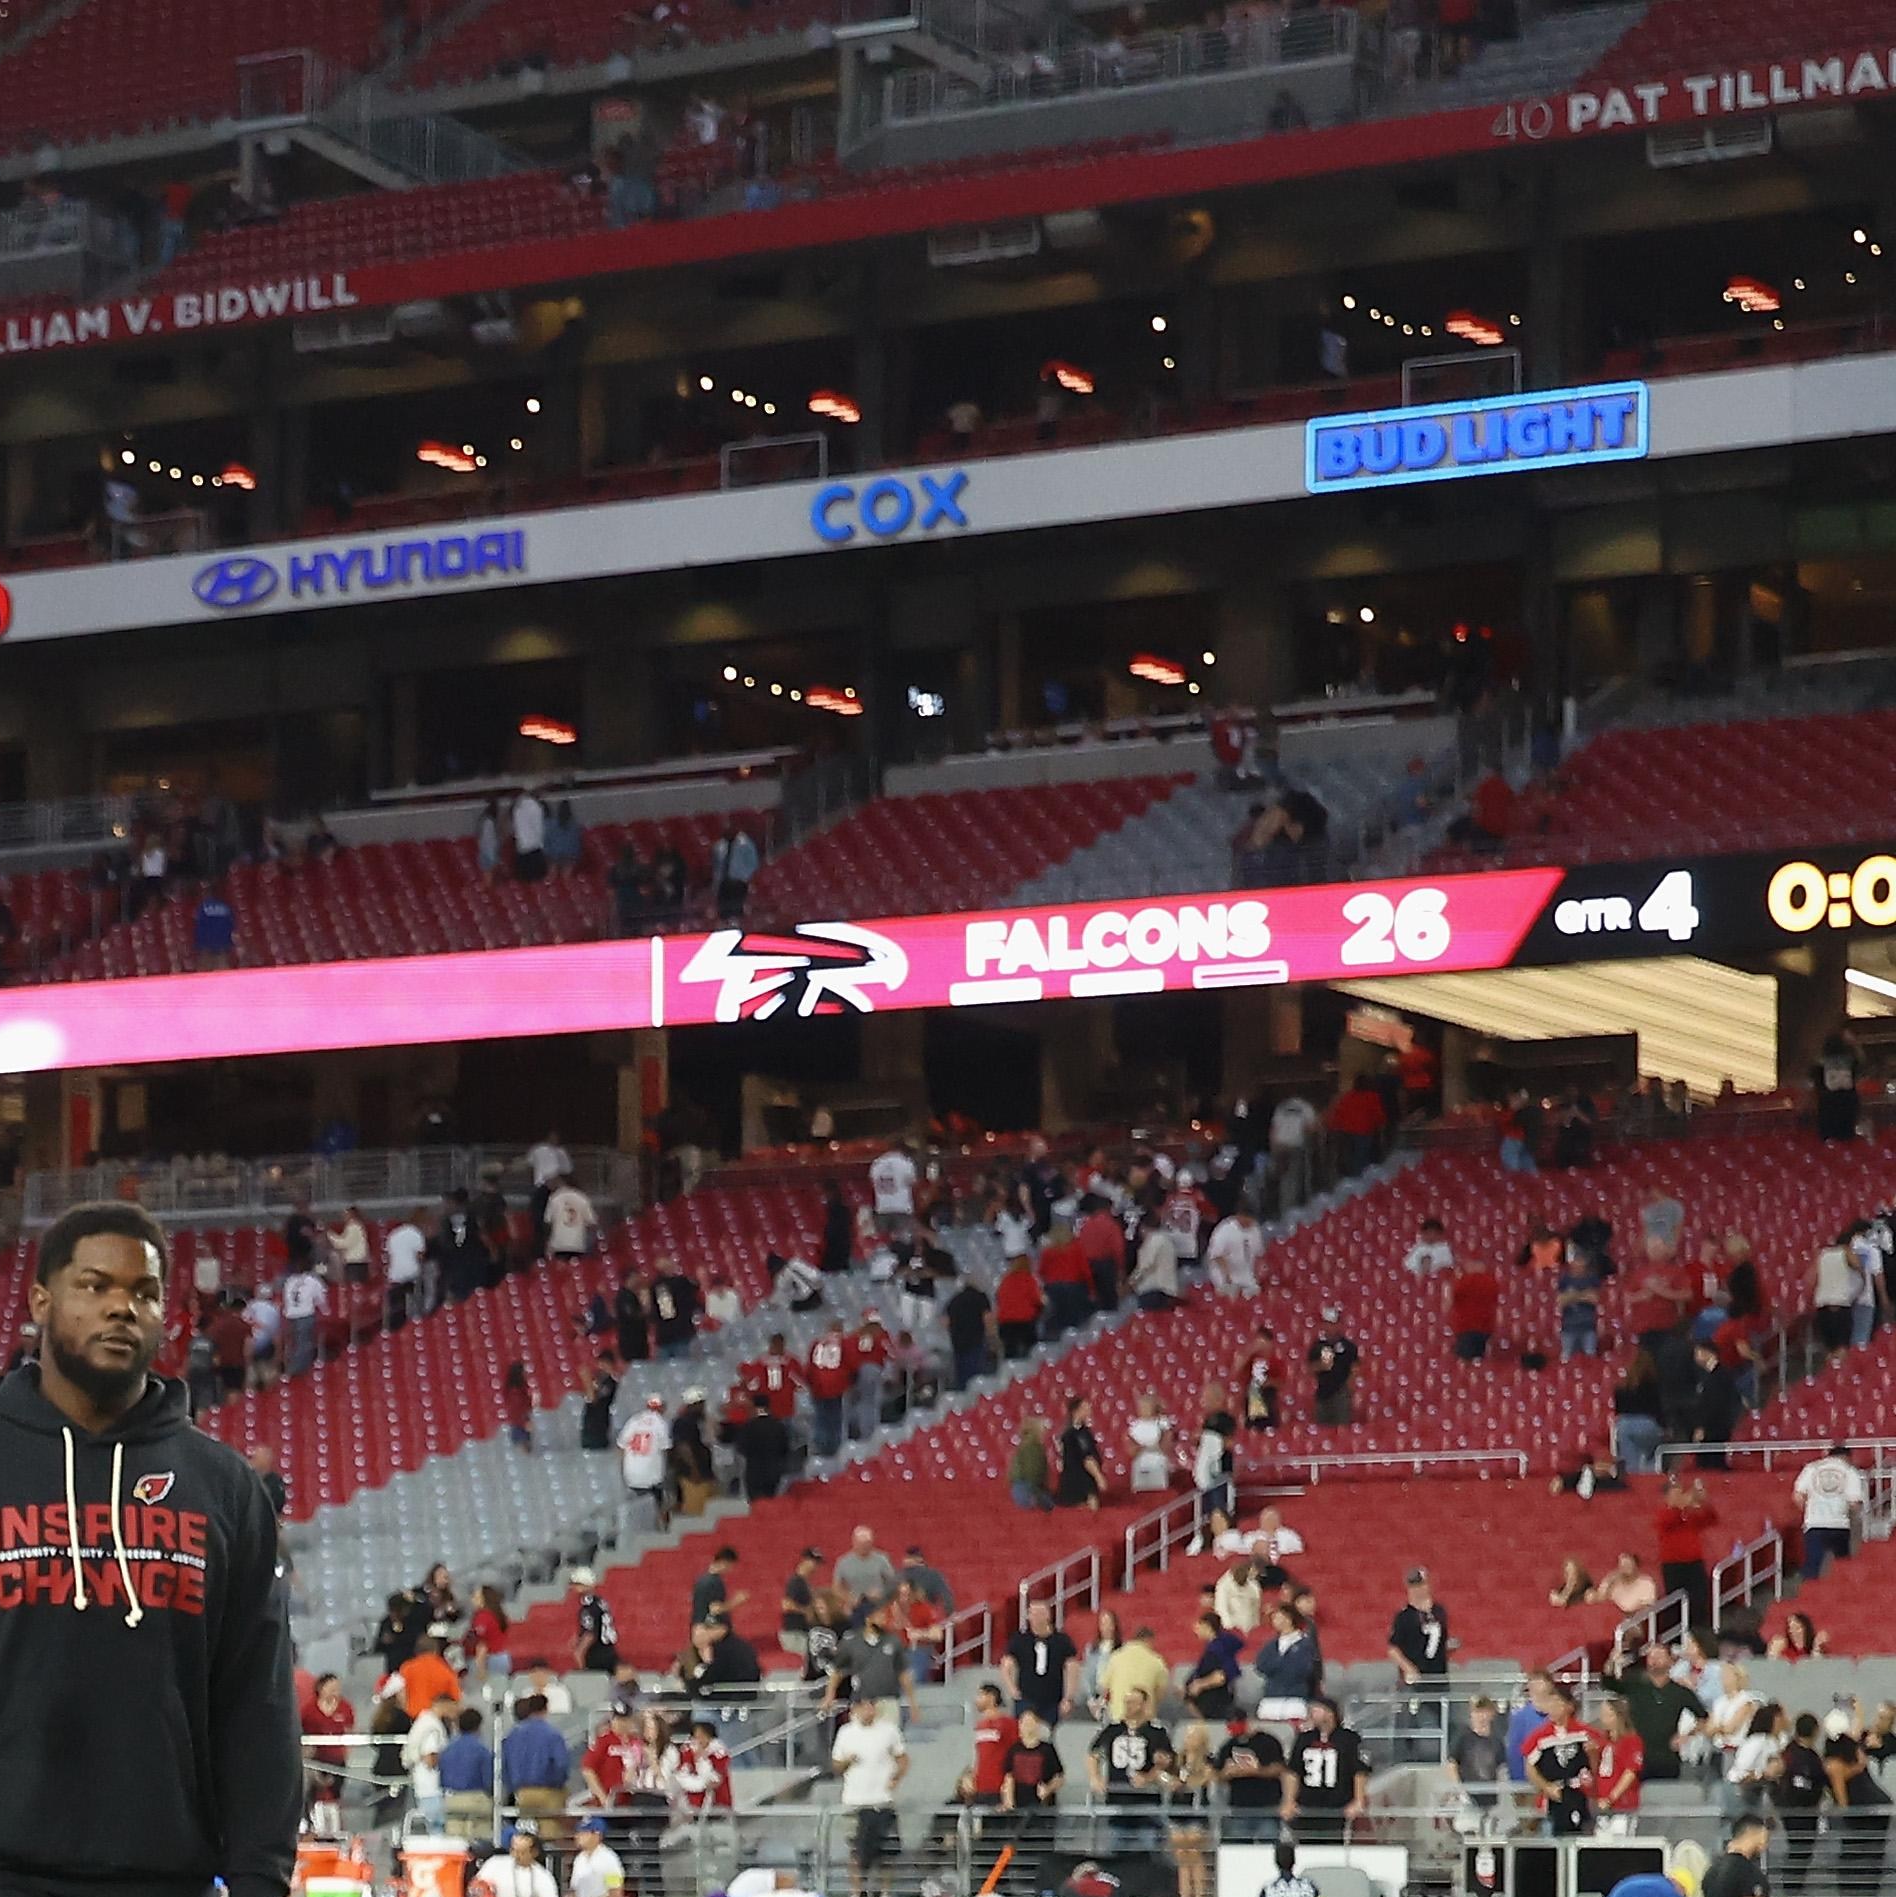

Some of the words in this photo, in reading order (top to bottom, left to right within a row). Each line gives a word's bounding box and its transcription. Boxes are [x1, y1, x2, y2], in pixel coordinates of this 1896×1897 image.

[1491, 100, 1553, 141] 40
[1566, 81, 1669, 134] PAT
[1682, 47, 1896, 115] TILLMA
[121, 298, 163, 336] V.
[172, 273, 361, 330] BIDWILL
[1315, 421, 1447, 482] BUD
[1450, 394, 1637, 466] LIGHT
[808, 470, 969, 543] COX
[289, 528, 526, 597] HYUNDAI
[965, 899, 1271, 978] FALCONS
[1340, 887, 1451, 967] 26
[1638, 869, 1700, 941] 4
